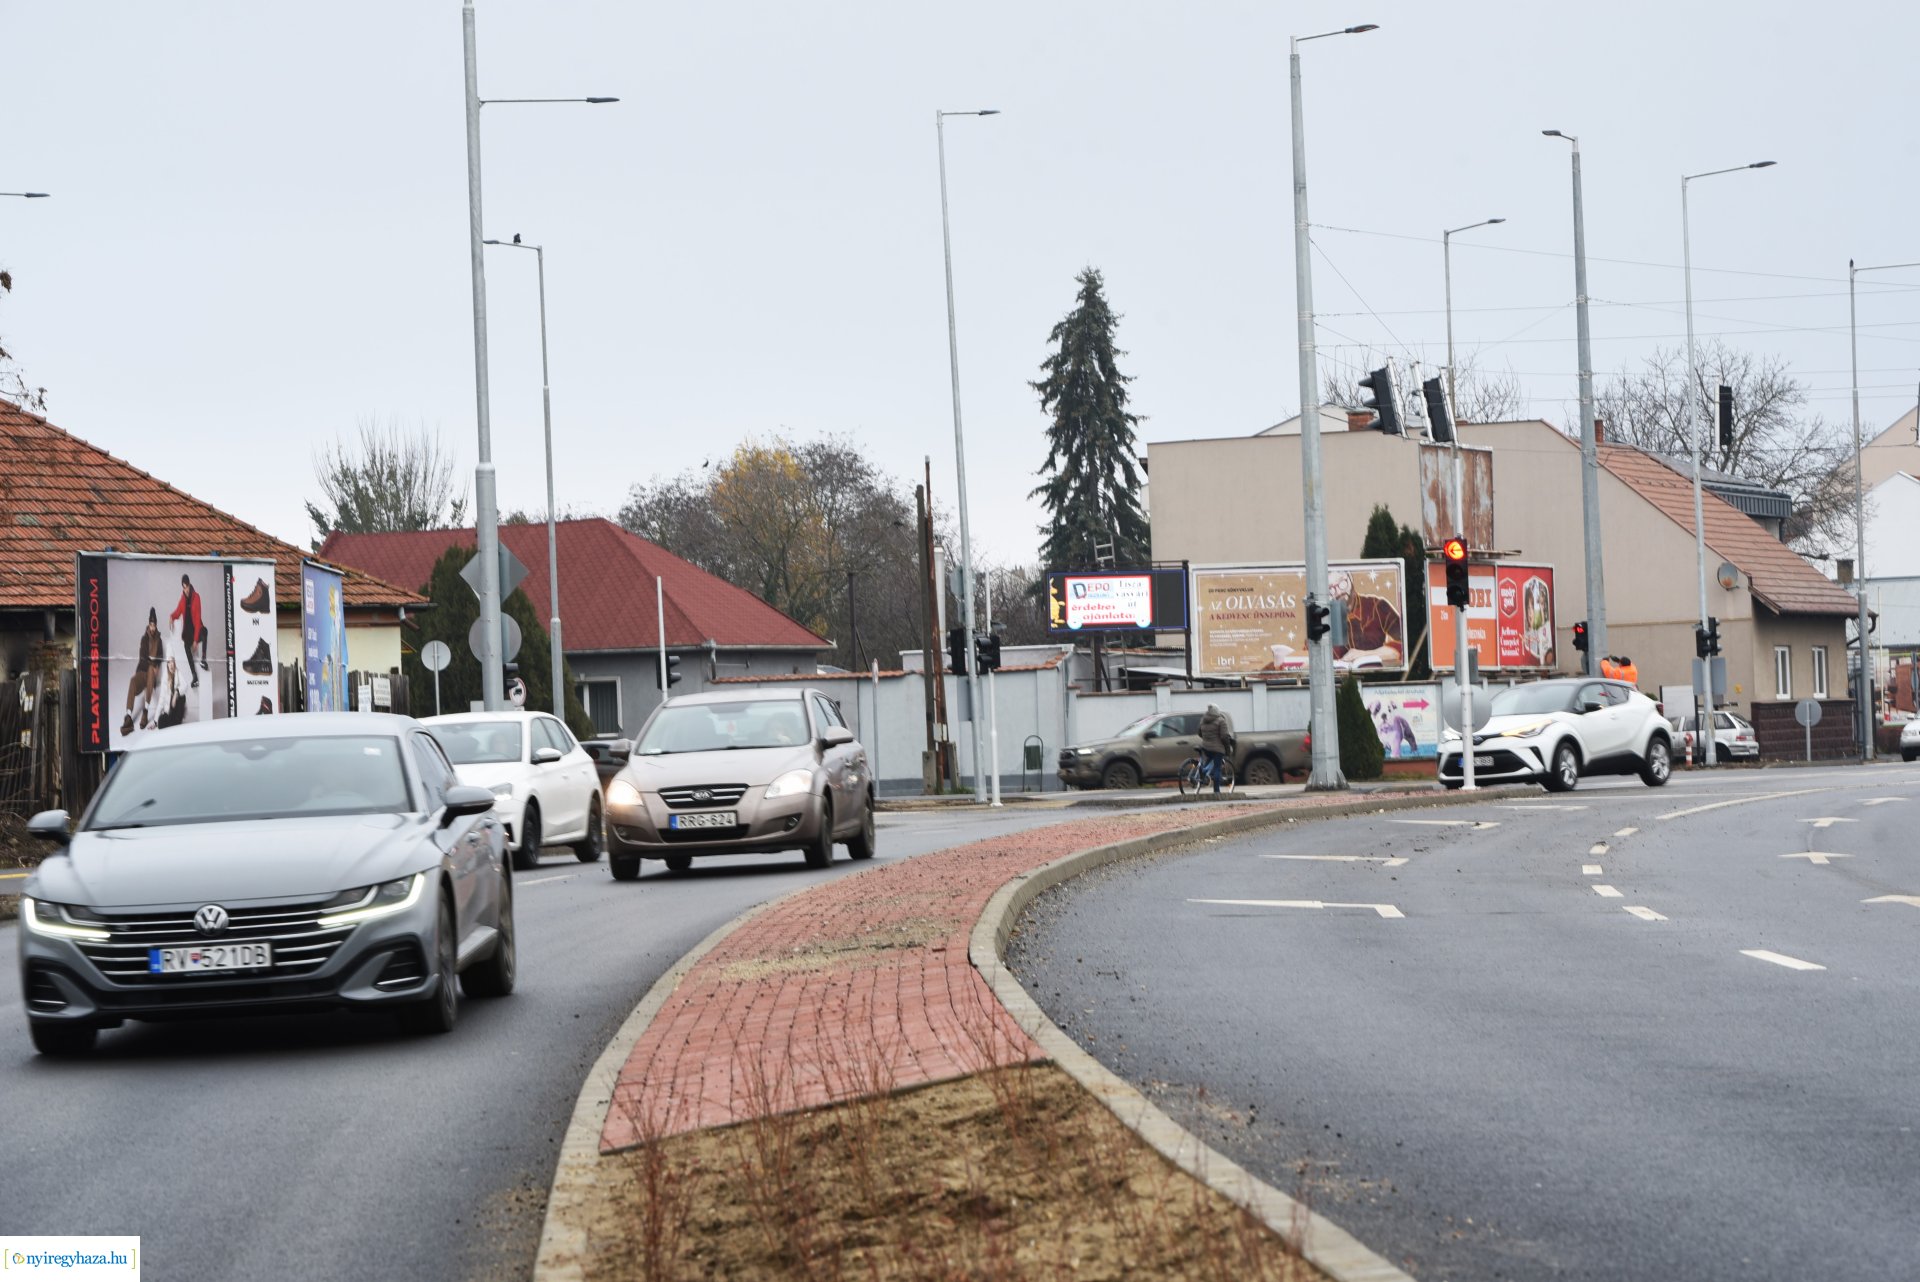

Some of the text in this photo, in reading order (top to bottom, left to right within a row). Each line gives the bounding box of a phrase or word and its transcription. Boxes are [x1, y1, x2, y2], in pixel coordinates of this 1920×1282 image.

[1072, 582, 1110, 599] DEPO
[1225, 592, 1296, 610] OLVASÁS
[225, 572, 234, 649] playersroom.hu
[1216, 612, 1251, 620] KEDVENC
[1253, 610, 1296, 619] ÜNNEPÜNK
[89, 577, 100, 745] PLAYERSROOM
[1209, 655, 1235, 666] Libri
[680, 813, 733, 828] RRG-624
